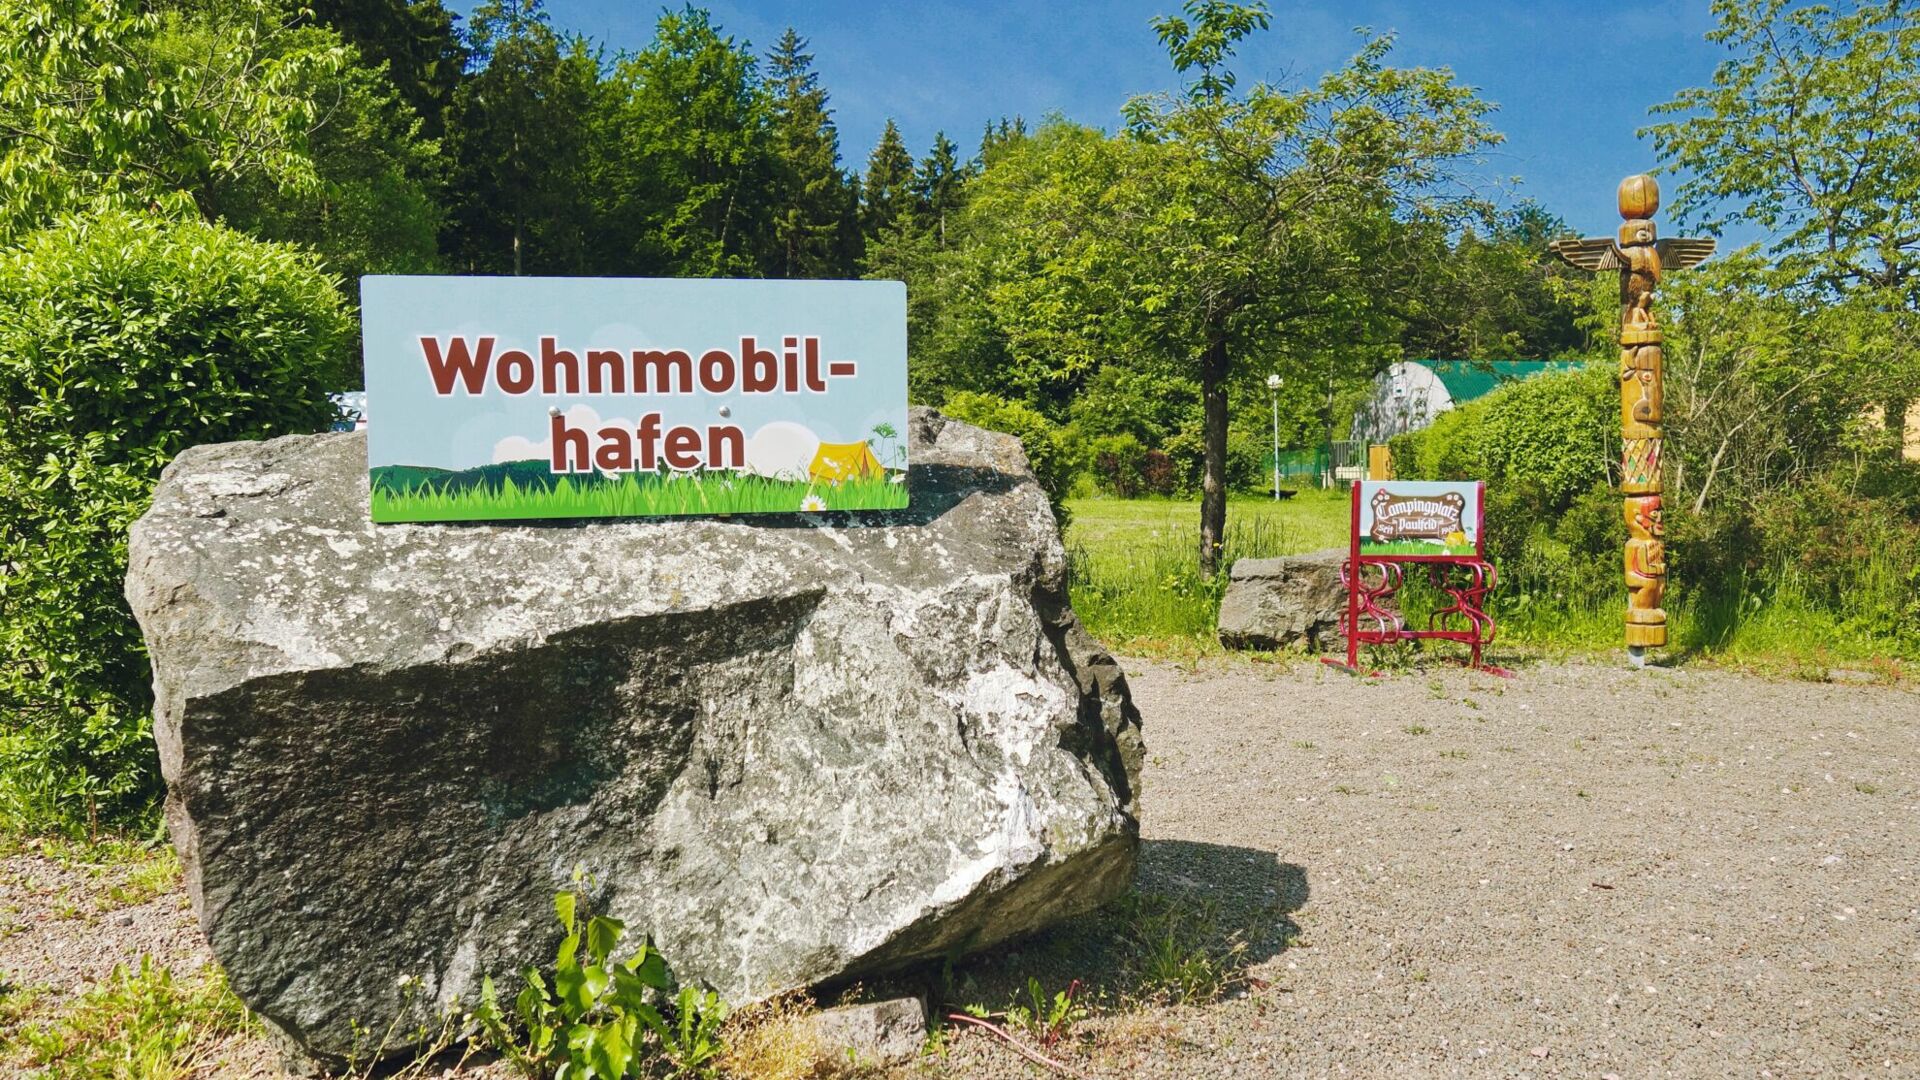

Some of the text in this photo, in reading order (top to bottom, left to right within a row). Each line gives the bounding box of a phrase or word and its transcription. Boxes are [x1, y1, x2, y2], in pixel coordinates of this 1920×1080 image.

[420, 336, 856, 395] Wohnmobil-
[551, 412, 746, 471] hafen
[1375, 498, 1459, 521] Campingplatz
[1398, 518, 1438, 532] Paulfeld
